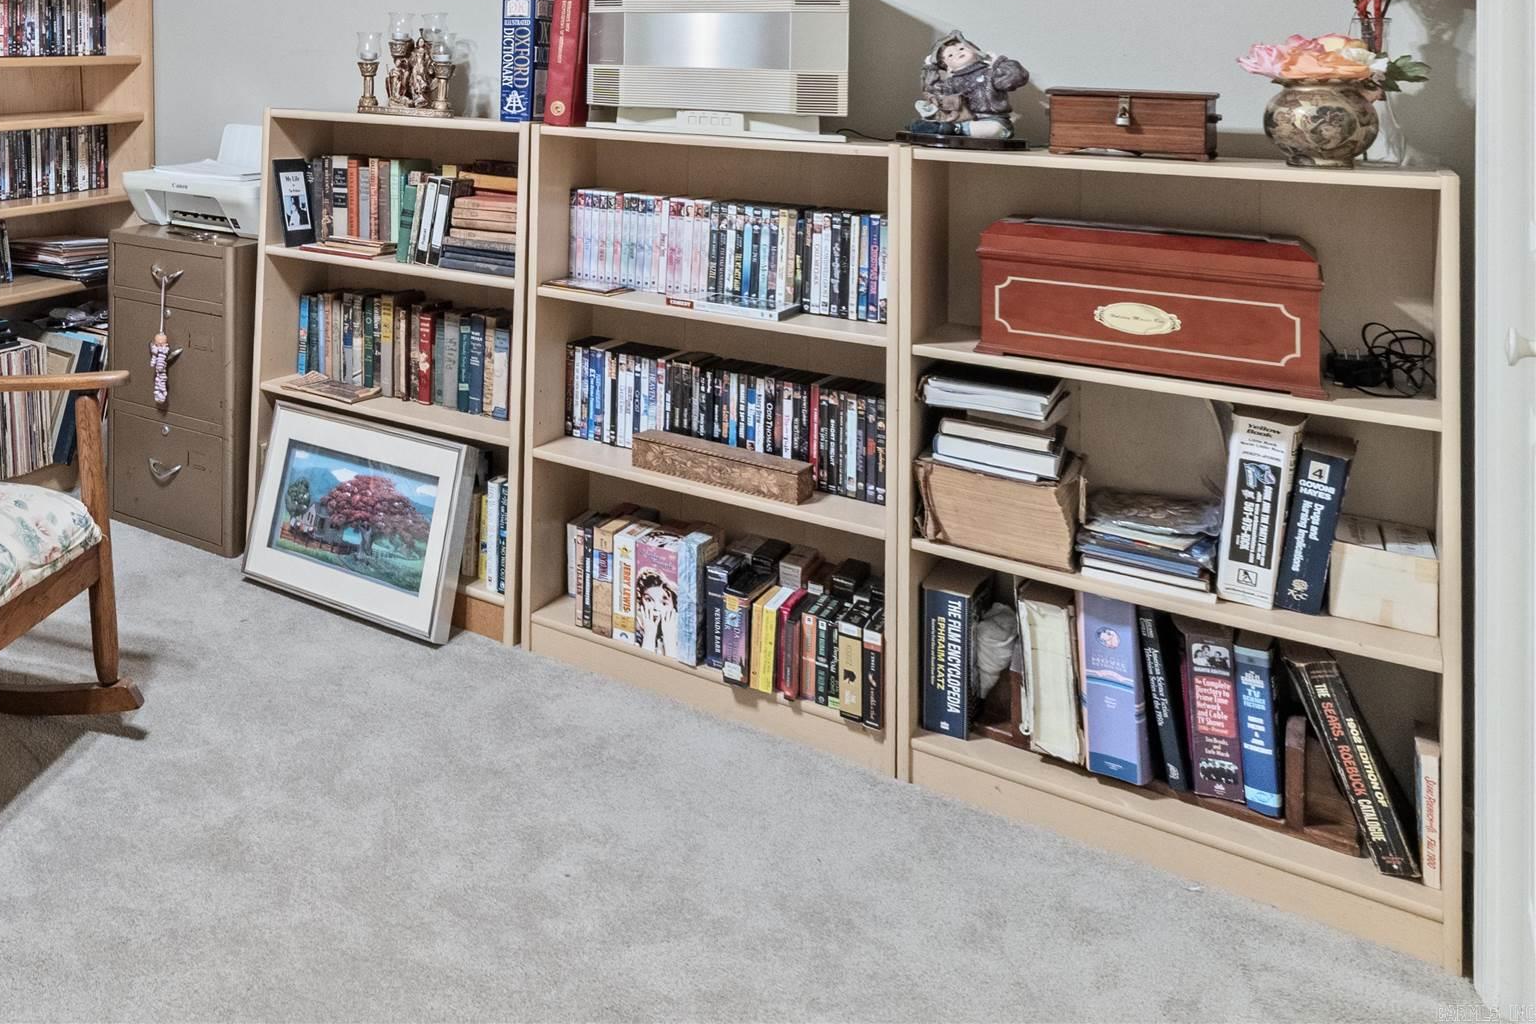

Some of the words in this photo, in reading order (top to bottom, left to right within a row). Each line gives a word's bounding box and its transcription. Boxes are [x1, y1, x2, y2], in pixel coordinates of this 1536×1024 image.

[502, 27, 514, 88] DICTIONARY
[513, 27, 530, 88] OXFORD
[648, 373, 656, 400] HEAVEN
[1246, 429, 1272, 438] Book
[1248, 424, 1281, 435] Yellow
[1312, 469, 1324, 479] 4
[1298, 480, 1336, 494] GOVONI
[1299, 487, 1332, 501] HAYES
[1297, 500, 1313, 528] Nursing
[1311, 503, 1324, 525] Drugs
[1239, 501, 1254, 550] 501-975-KICK
[1309, 525, 1319, 540] and
[1291, 529, 1307, 572] Implications
[948, 600, 961, 618] THE
[937, 616, 945, 662] EPHRAIM
[948, 620, 961, 642] FILM
[1144, 648, 1153, 675] Television
[1151, 648, 1161, 675] American
[947, 643, 961, 713] ENCYCLOPEDIA
[1148, 676, 1156, 692] Series
[1156, 676, 1165, 696] Science
[1202, 680, 1231, 690] Complete
[1196, 686, 1219, 697] Directory
[1220, 690, 1230, 698] to
[1196, 694, 1212, 703] Prime
[1213, 696, 1228, 706] Time
[1246, 688, 1260, 698] TV
[1160, 698, 1169, 718] Fiction
[1196, 701, 1221, 711] Network
[1197, 708, 1207, 716] and
[1209, 710, 1228, 721] Cable
[1155, 710, 1163, 727] 1950s
[1197, 716, 1205, 724] TV
[1206, 717, 1224, 728] Shows
[1313, 683, 1330, 698] THE
[1337, 744, 1367, 796] ROEBUCK
[1357, 799, 1386, 842] CATALOGUE
[1345, 717, 1361, 744] 1902
[1357, 745, 1381, 790] EDITION
[1375, 790, 1388, 807] OF
[1427, 852, 1436, 869] 1900
